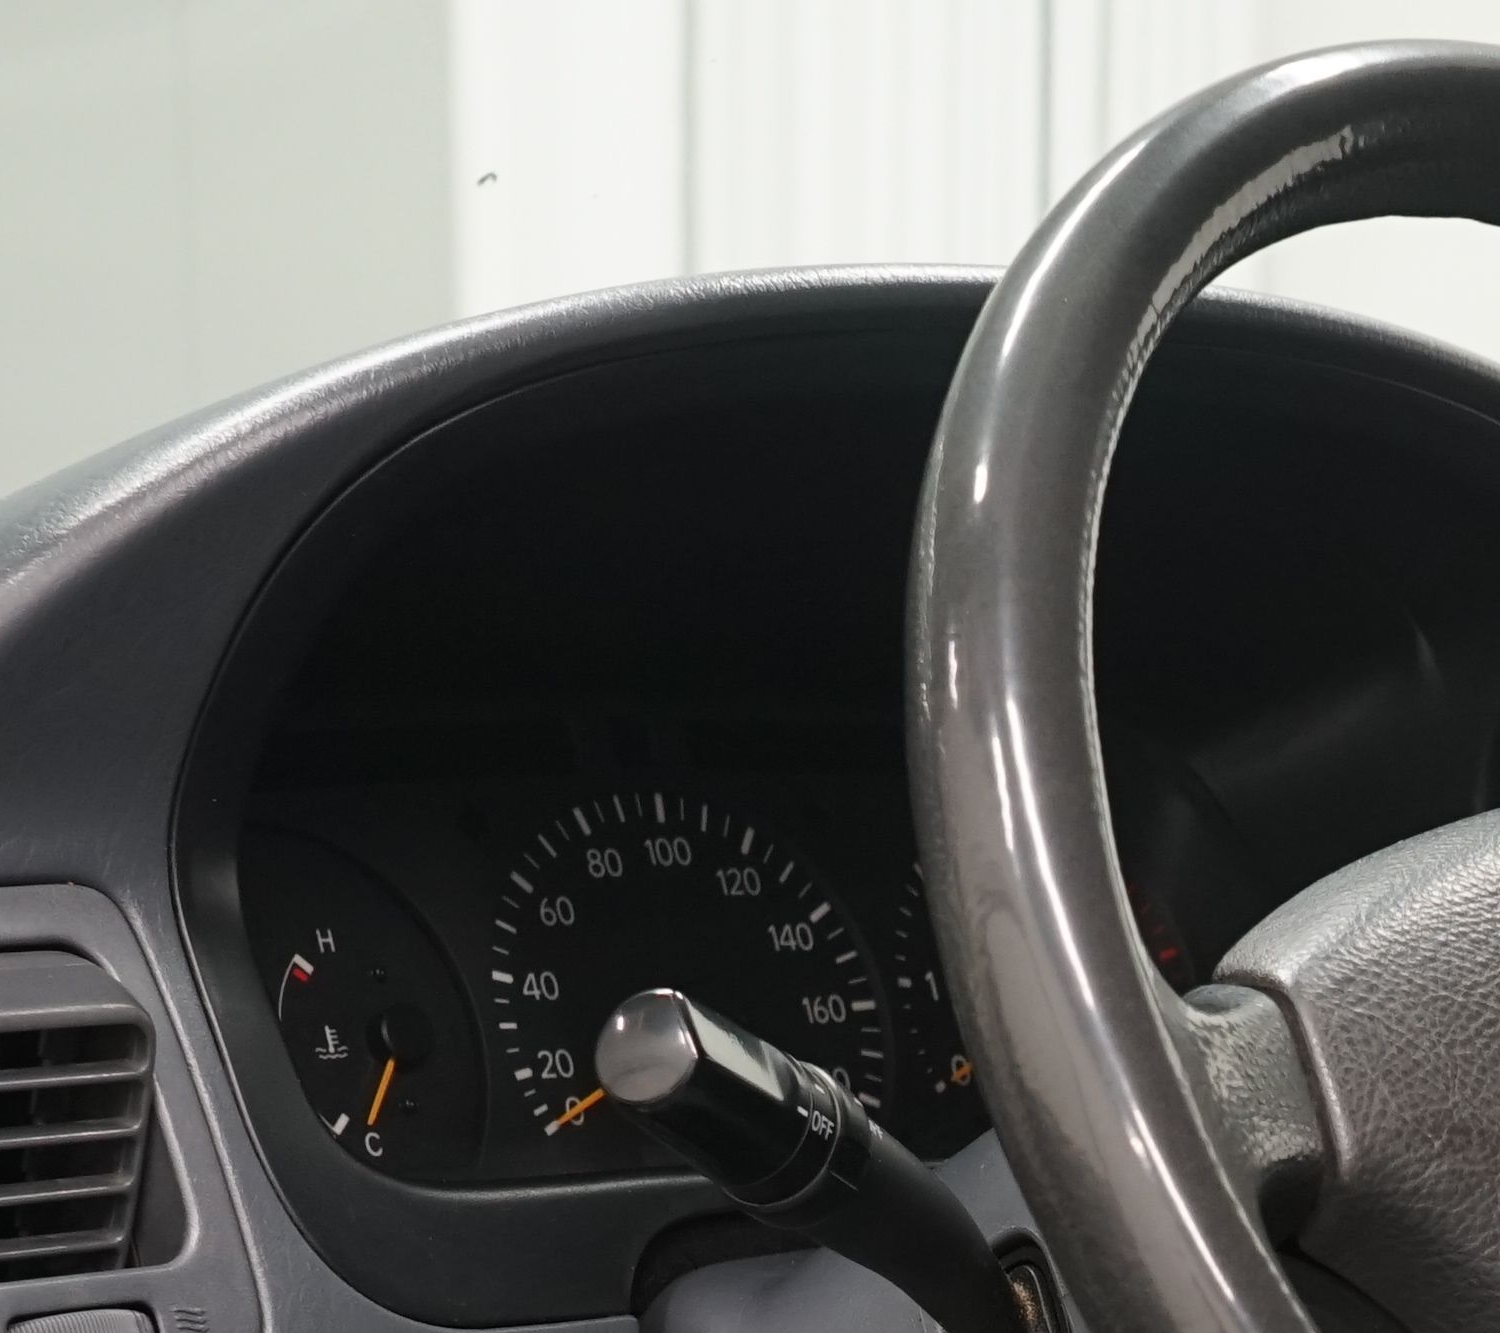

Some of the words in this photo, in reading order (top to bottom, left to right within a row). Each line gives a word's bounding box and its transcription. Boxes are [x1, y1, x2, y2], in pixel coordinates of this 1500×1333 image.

[586, 848, 624, 878] 80
[644, 836, 693, 867] 100
[716, 866, 762, 896] 120
[539, 895, 575, 927] 60
[316, 928, 336, 953] H
[768, 922, 815, 952] 140
[522, 971, 559, 1002] 40
[802, 994, 847, 1024] 160
[537, 1048, 574, 1079] 20
[565, 1096, 585, 1127] 0
[811, 1110, 835, 1140] OFF
[364, 1131, 384, 1157] C
